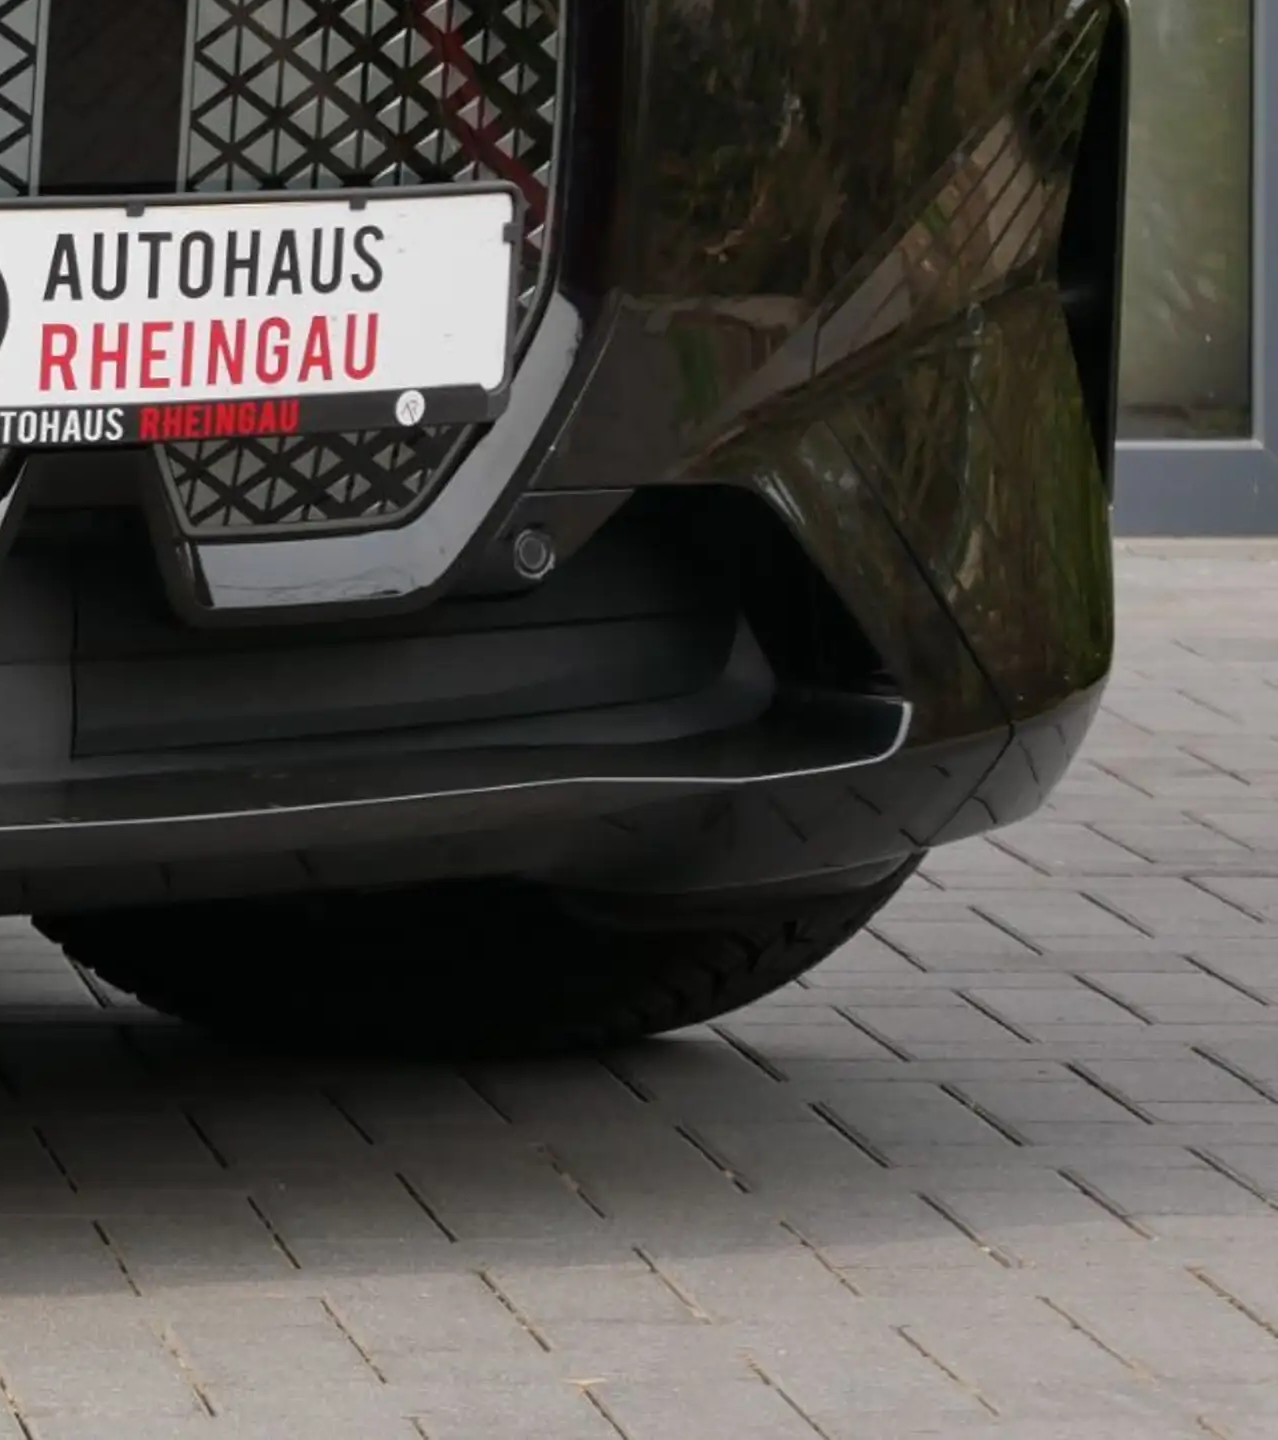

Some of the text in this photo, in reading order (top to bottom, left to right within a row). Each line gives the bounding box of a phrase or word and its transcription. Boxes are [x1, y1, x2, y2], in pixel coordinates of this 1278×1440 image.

[43, 225, 384, 301] AUTOHAUS
[39, 312, 379, 391] RHEINGAU
[139, 400, 299, 440] RHEINGAU
